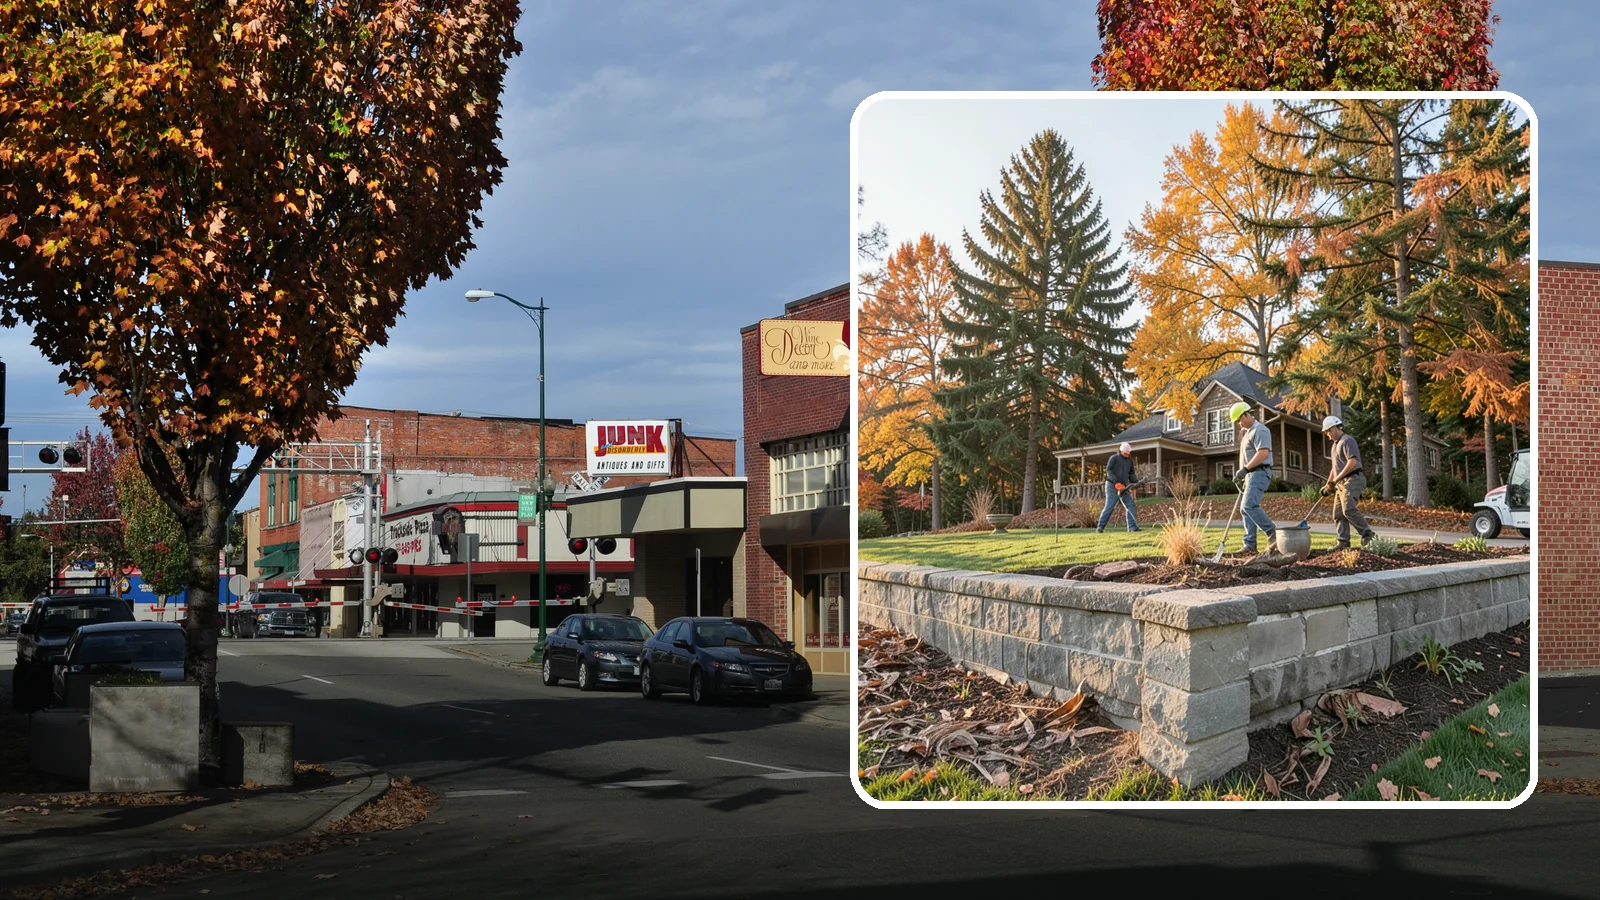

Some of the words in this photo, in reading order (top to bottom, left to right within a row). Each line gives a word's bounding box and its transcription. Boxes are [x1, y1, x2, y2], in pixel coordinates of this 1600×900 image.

[595, 425, 665, 457] JUNK
[607, 446, 646, 454] DISORDERLY
[596, 461, 628, 470] ANTIQUES
[631, 461, 643, 470] AND
[646, 460, 665, 470] GIFTS
[390, 522, 413, 539] Trackside
[414, 519, 429, 535] Pizza
